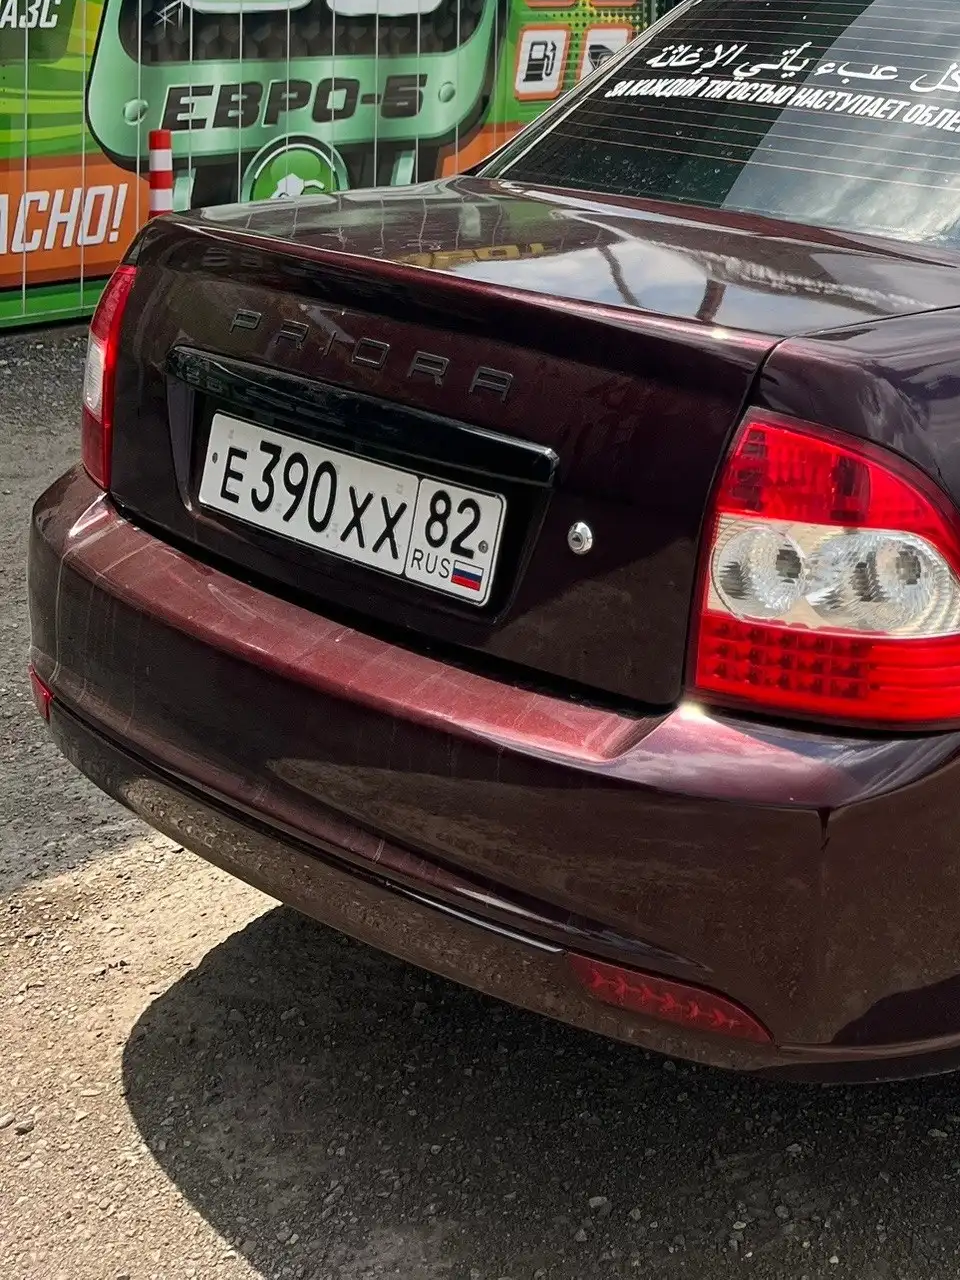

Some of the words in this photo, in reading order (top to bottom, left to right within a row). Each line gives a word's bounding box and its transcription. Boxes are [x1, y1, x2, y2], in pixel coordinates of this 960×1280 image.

[604, 80, 630, 99] ЗА
[624, 76, 704, 99] КАЖДОЙ
[697, 79, 797, 105] ТЯГОСТЬЮ
[787, 87, 911, 121] НАСТУПАЕТ
[814, 61, 899, 84] عبء
[160, 73, 428, 132] ЕВРО-5
[229, 307, 515, 403] PRIORA
[219, 440, 408, 560] Е390ХХ
[424, 489, 482, 560] 82
[410, 548, 451, 580] RUS
